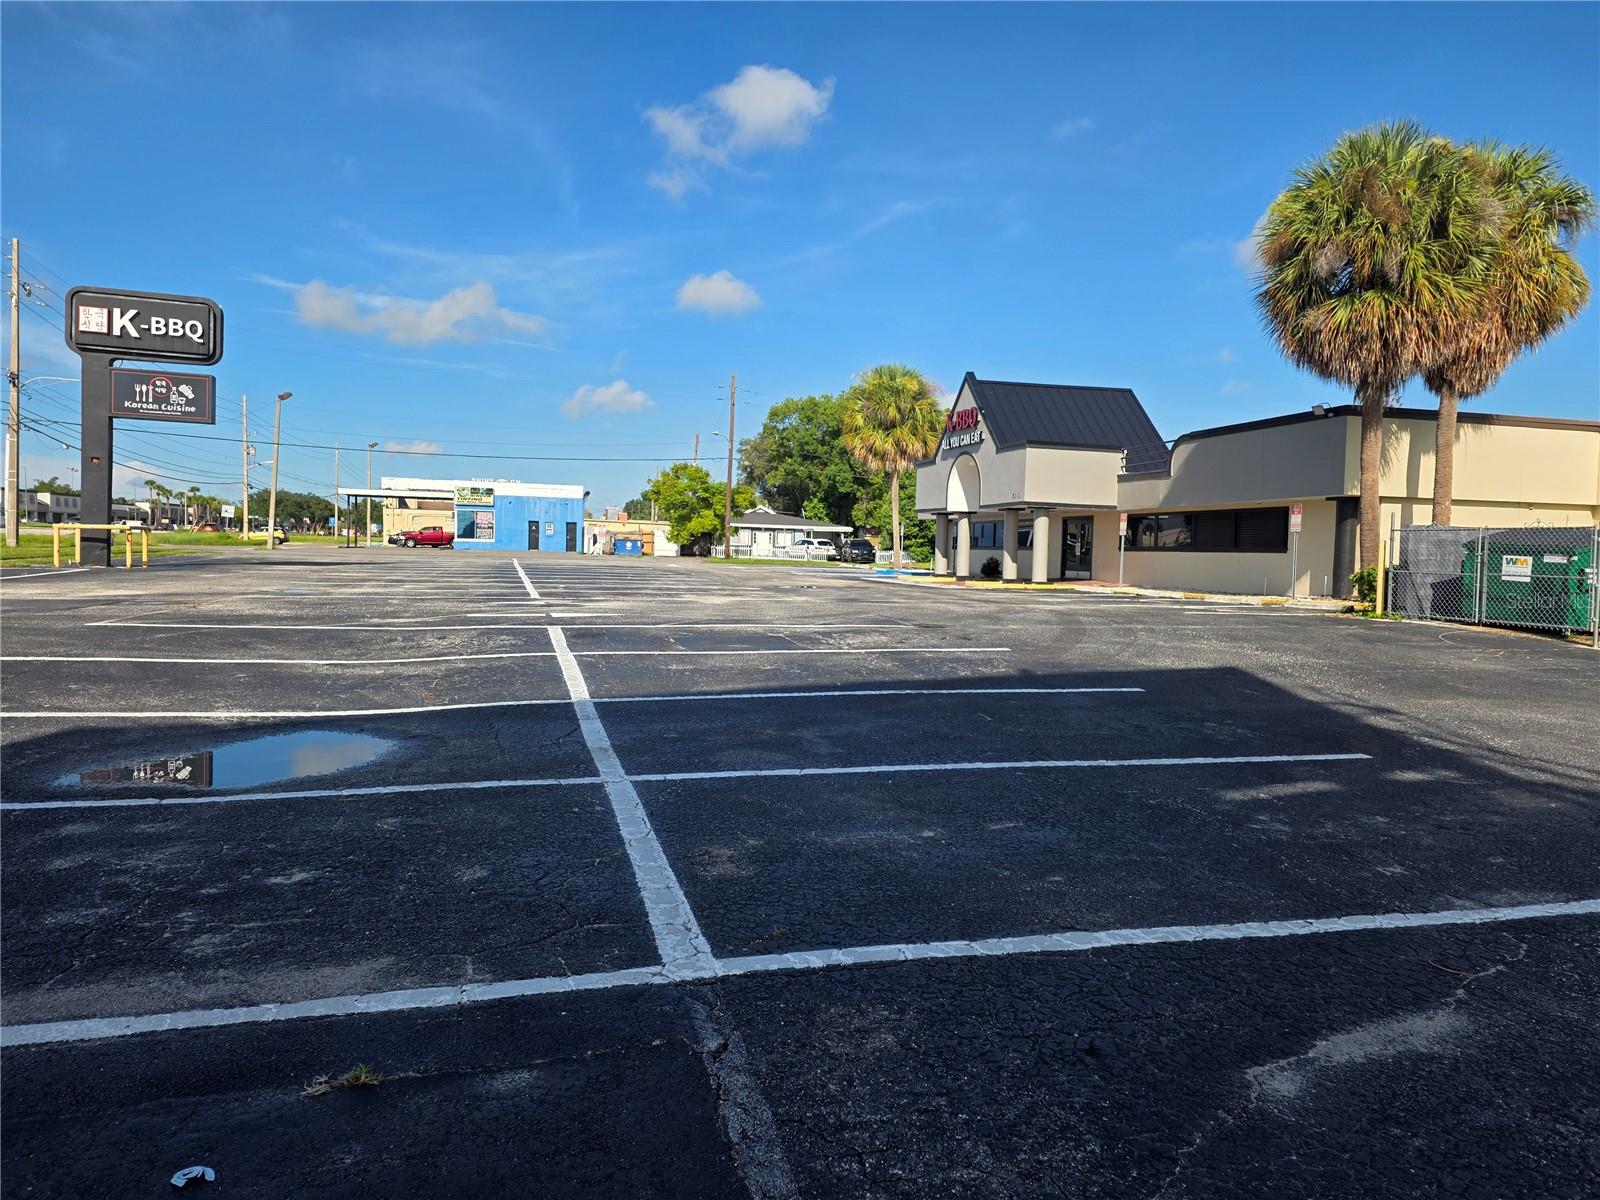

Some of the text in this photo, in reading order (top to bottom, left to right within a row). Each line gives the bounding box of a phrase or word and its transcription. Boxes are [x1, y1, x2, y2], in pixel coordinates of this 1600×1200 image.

[112, 307, 204, 343] K-BBQ
[124, 400, 159, 410] Korean
[161, 403, 196, 413] Cuisine
[946, 407, 977, 432] K-BBQ
[942, 431, 981, 450] ALL YOU CAN EAT
[1505, 557, 1529, 566] WM
